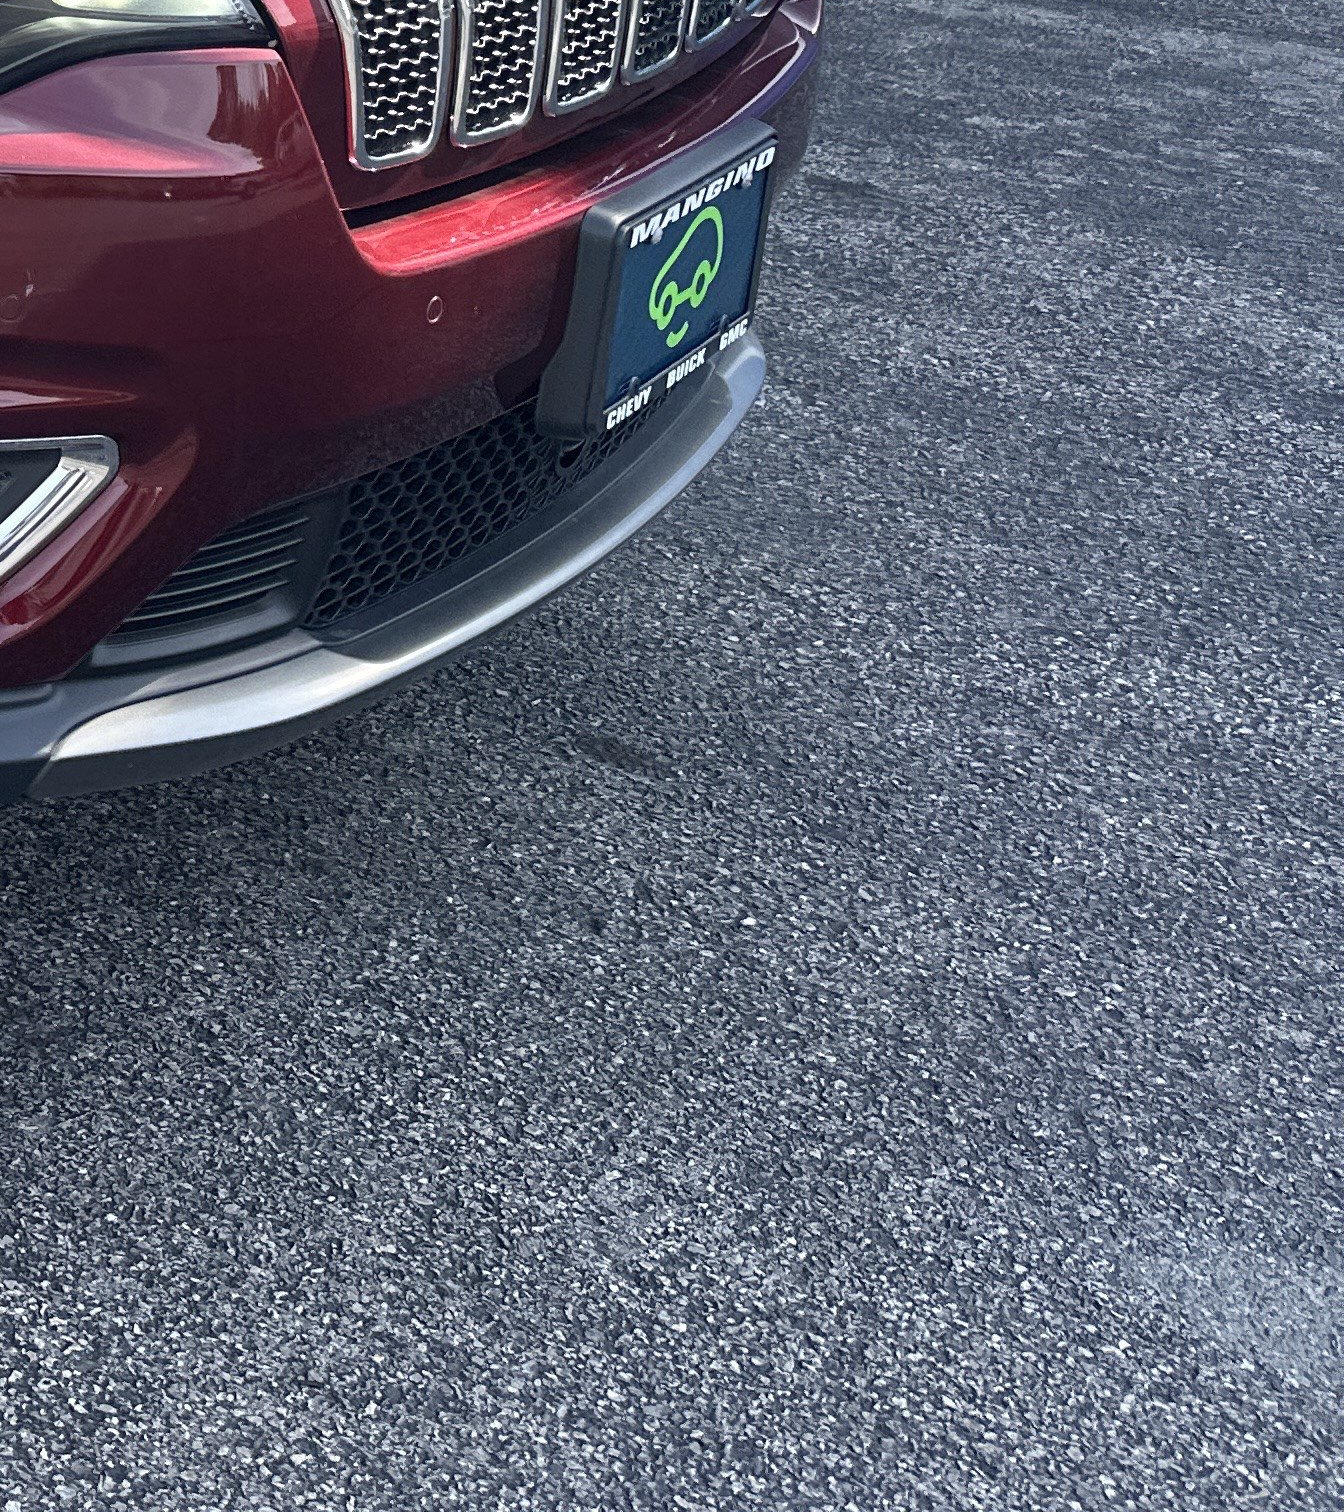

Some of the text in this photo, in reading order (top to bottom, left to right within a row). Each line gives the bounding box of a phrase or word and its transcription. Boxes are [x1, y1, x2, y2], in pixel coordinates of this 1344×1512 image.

[629, 146, 777, 249] MANGINO
[605, 318, 749, 431] CHEVY BUICK GMC
